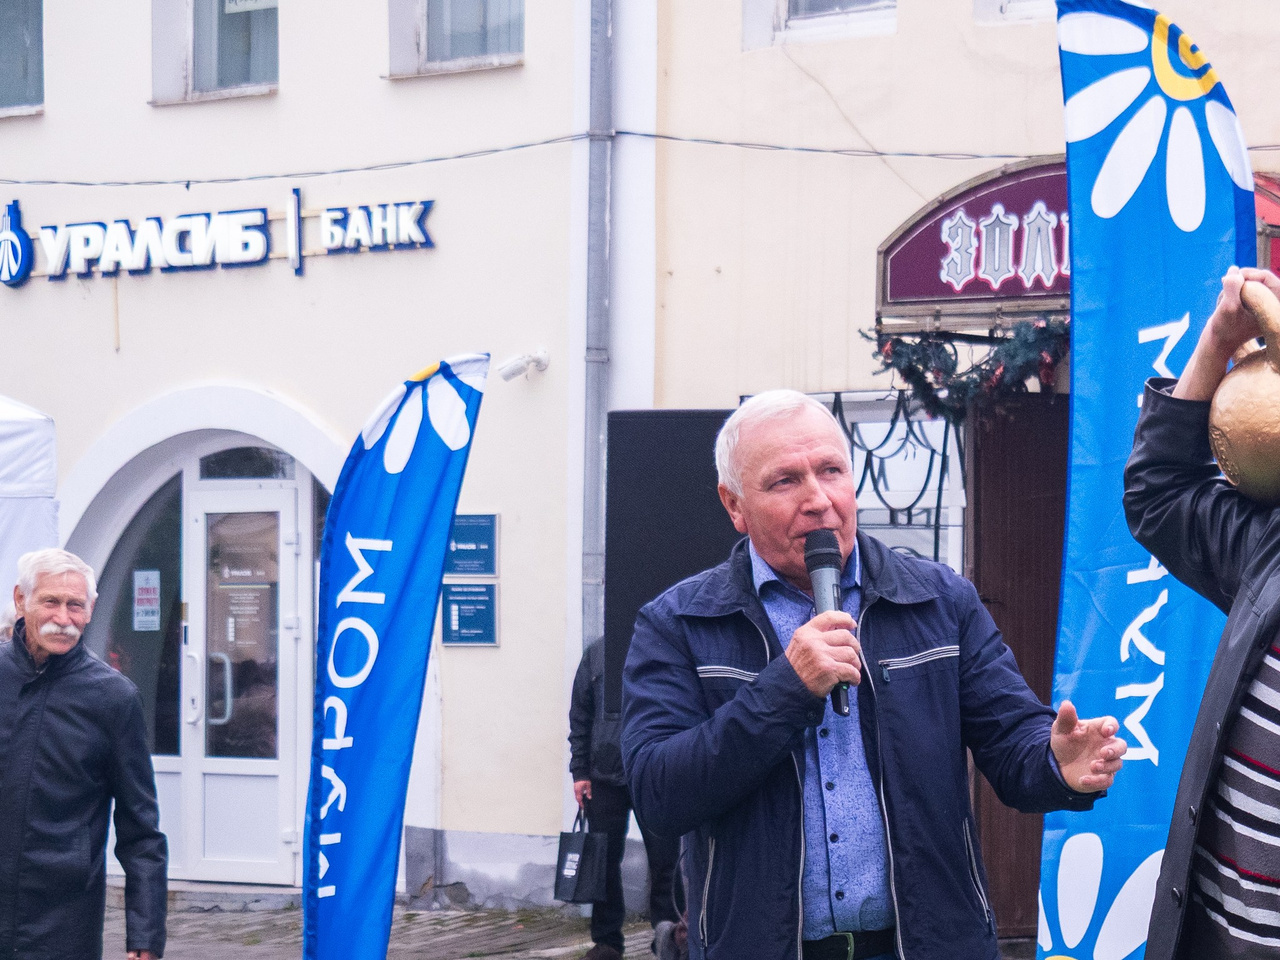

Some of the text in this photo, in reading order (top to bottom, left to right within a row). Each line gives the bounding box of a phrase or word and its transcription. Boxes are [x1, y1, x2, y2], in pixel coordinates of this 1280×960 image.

[40, 200, 436, 281] УРАЛСИБ БАНК
[940, 200, 1070, 293] ЗОЛ
